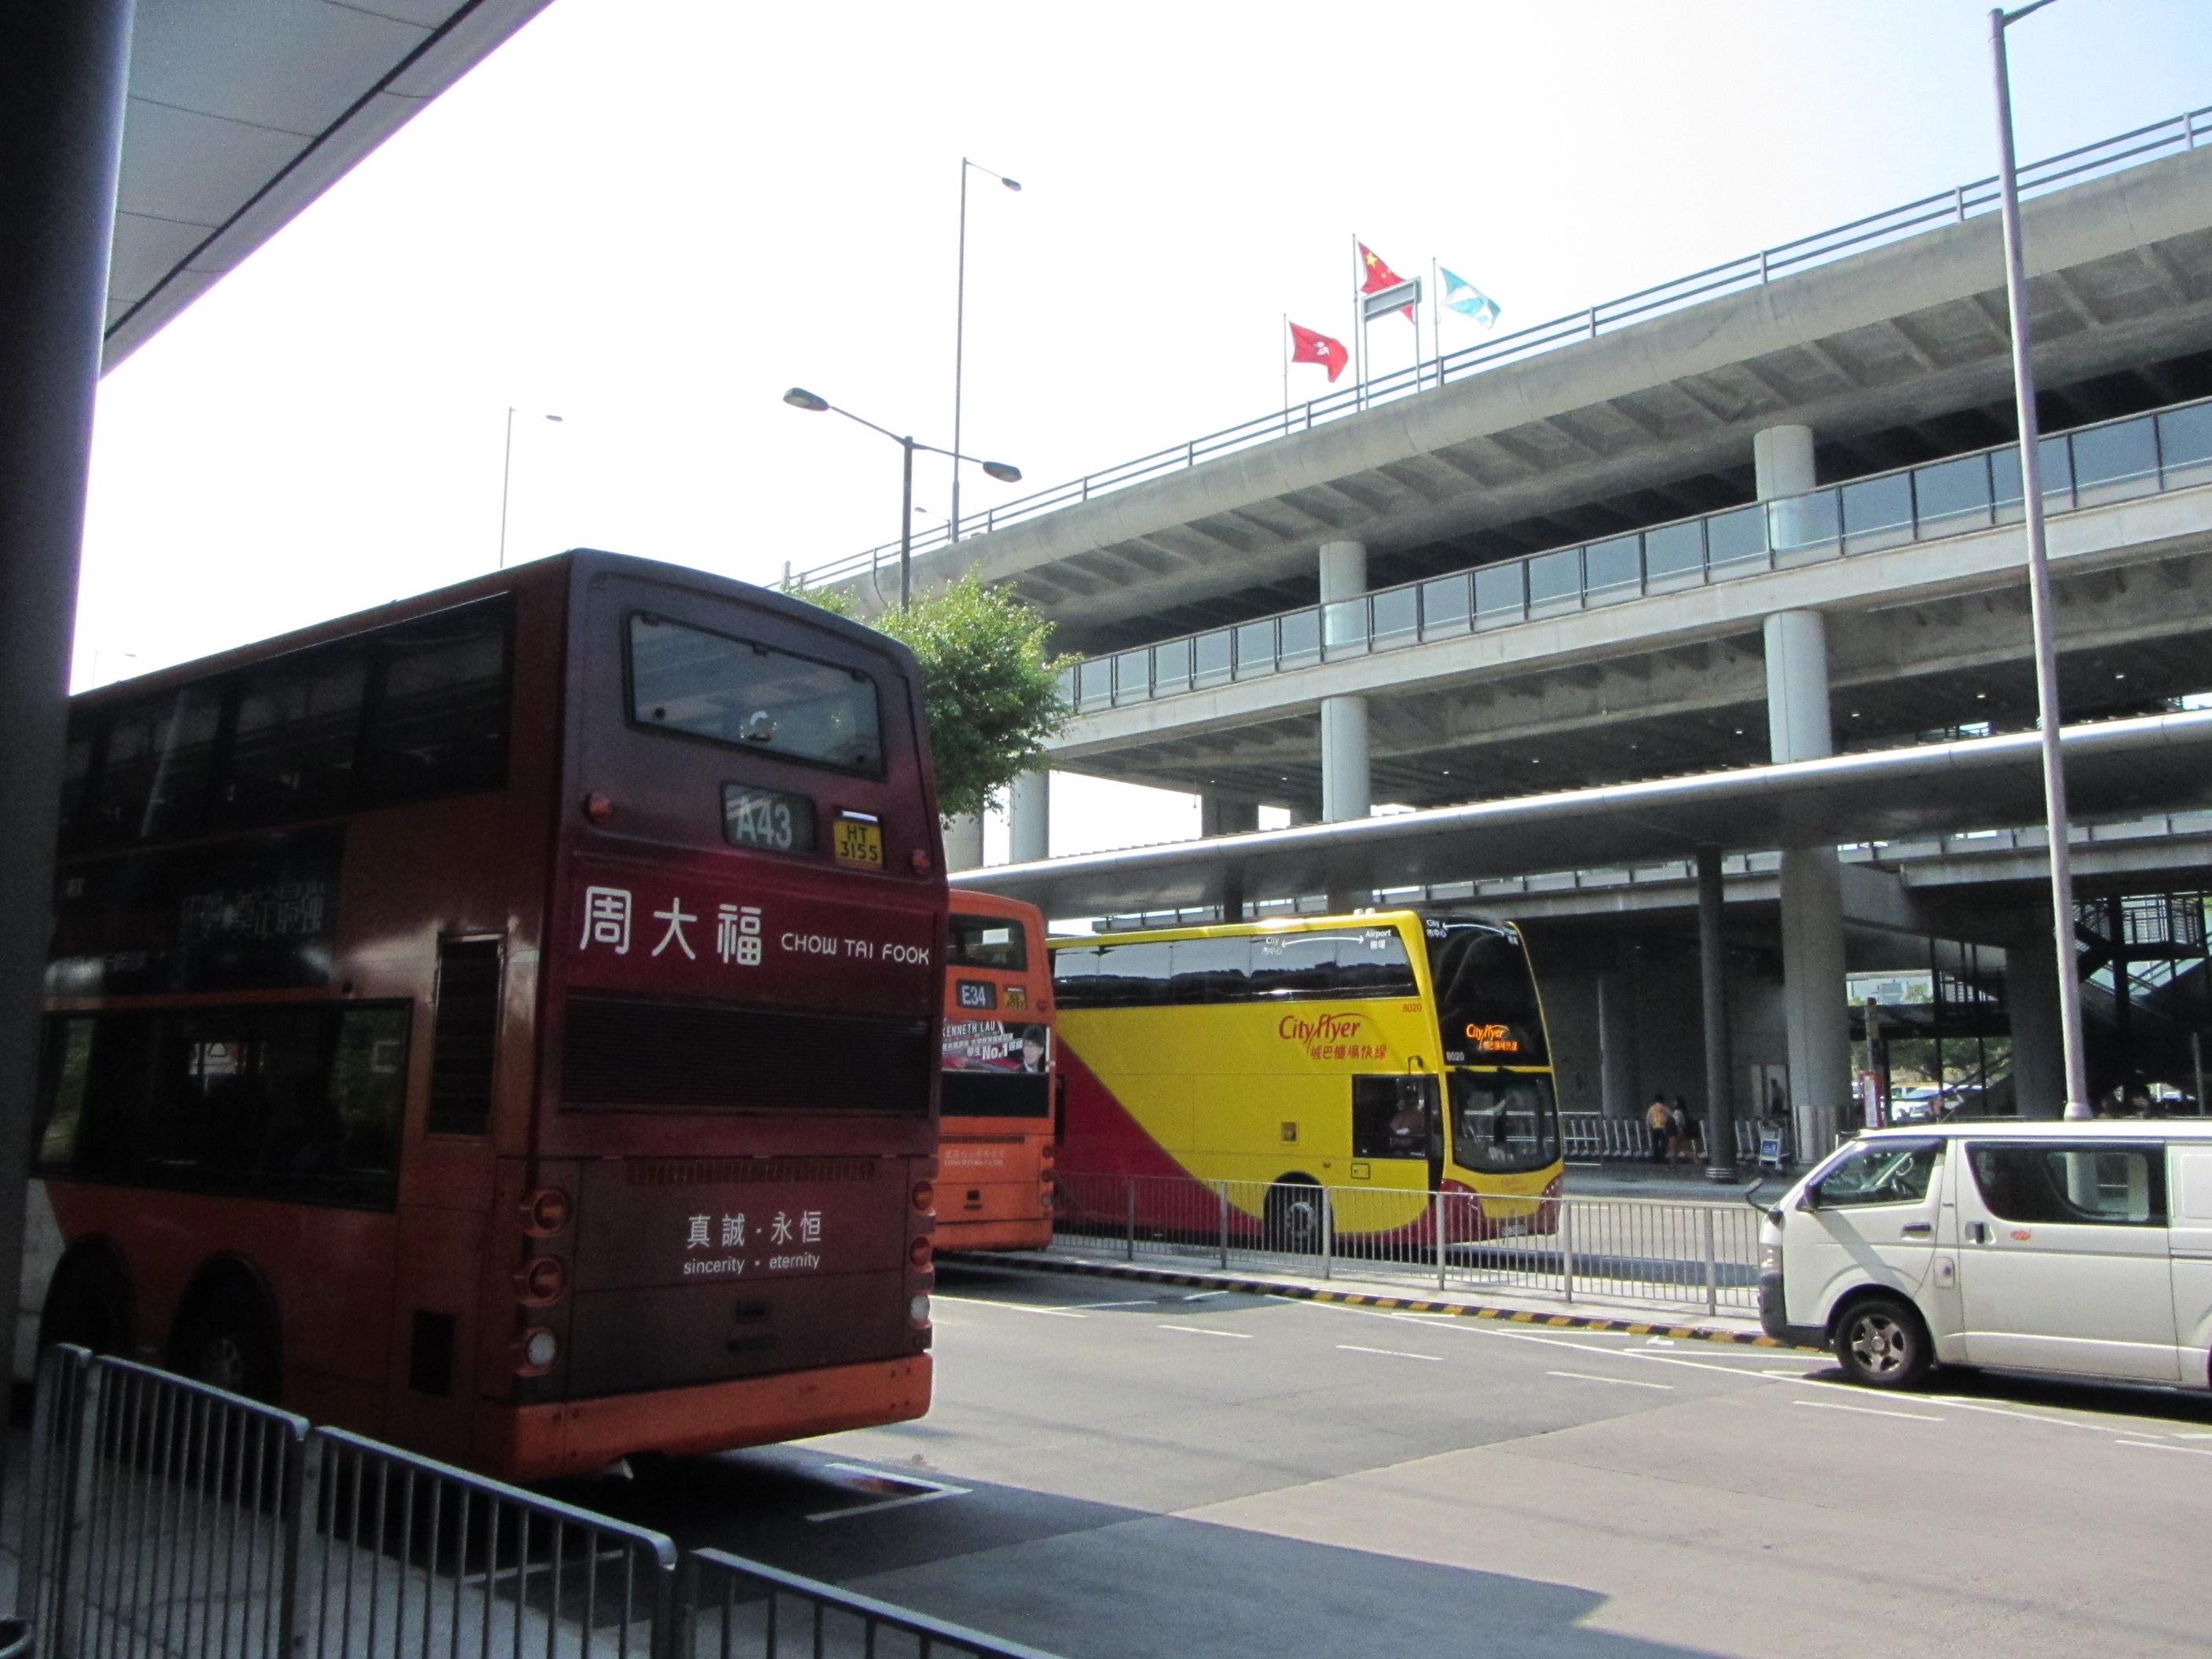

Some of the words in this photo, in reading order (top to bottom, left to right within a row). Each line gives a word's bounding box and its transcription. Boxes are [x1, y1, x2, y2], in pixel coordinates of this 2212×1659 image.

[736, 796, 793, 848] A43
[847, 824, 867, 844] HT
[840, 840, 879, 862] 3155
[580, 885, 762, 965] 周大福
[1364, 929, 1391, 939] Airport
[782, 932, 837, 955] CHOW
[844, 939, 873, 959] TAI
[881, 943, 929, 965] FOOK
[961, 985, 986, 1005] E34
[1402, 1003, 1422, 1012] 8020
[683, 1257, 745, 1275] sincerity
[769, 1252, 820, 1269] eternity
